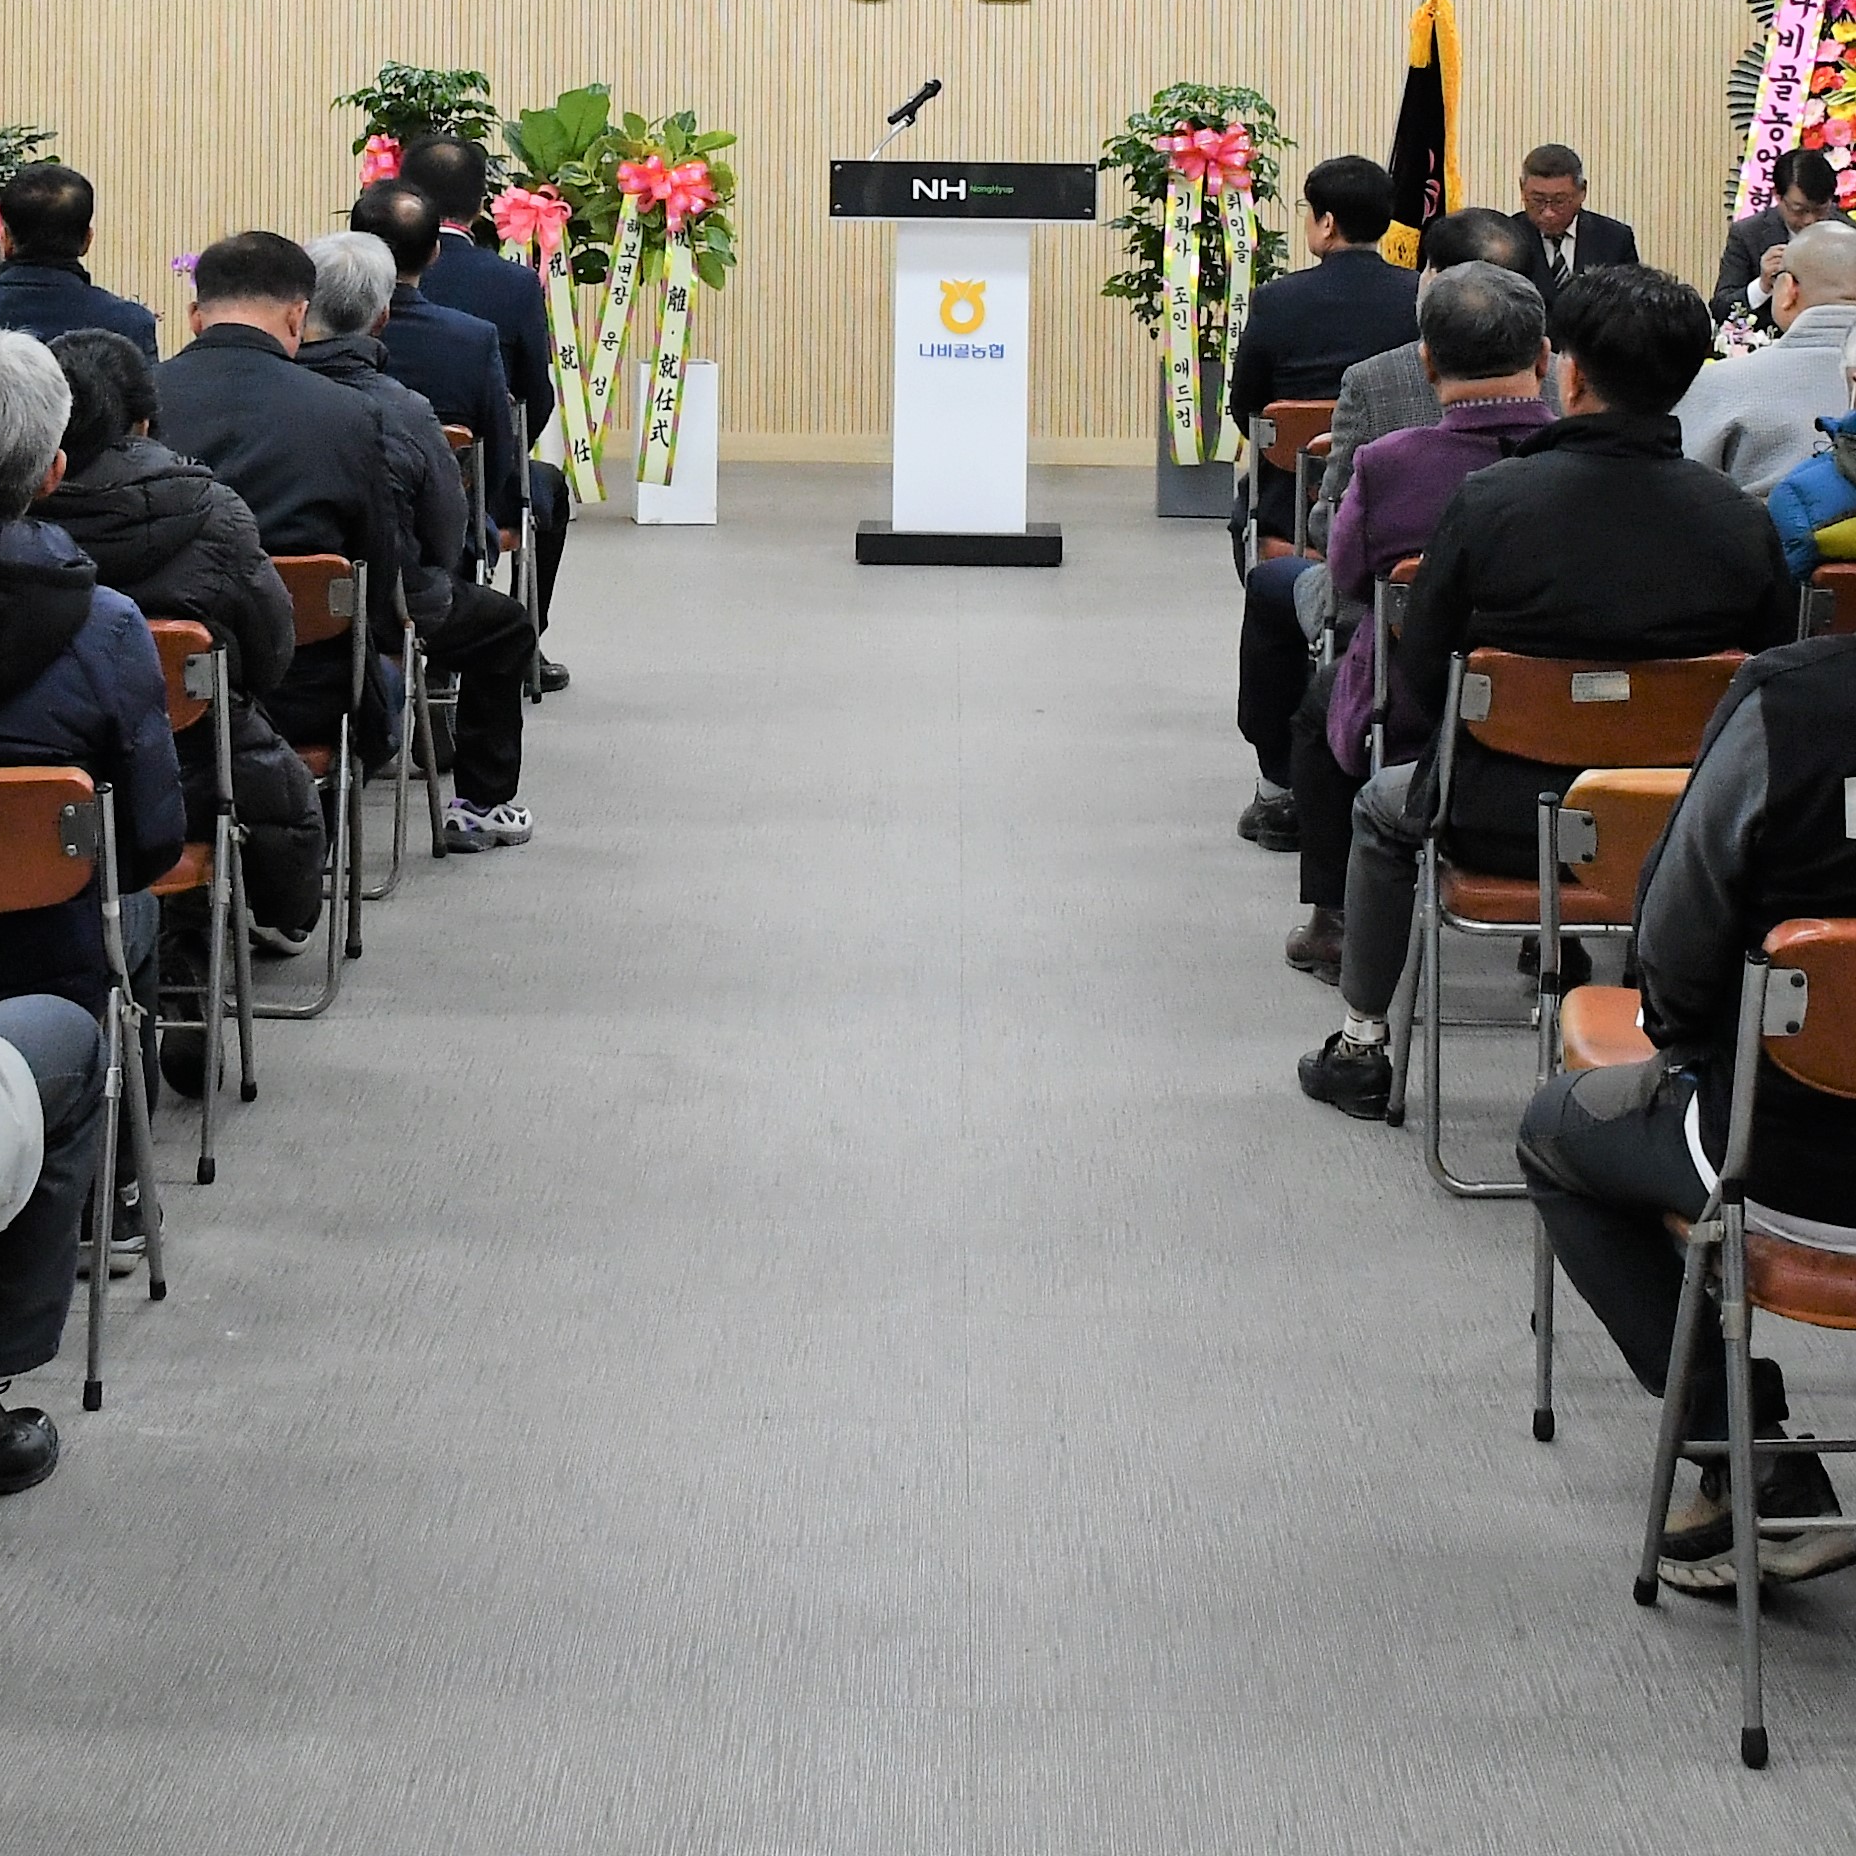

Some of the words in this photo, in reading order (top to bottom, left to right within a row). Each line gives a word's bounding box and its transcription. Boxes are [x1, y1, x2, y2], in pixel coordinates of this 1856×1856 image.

[911, 178, 967, 201] NH
[1173, 191, 1192, 259] 기획사
[1226, 191, 1250, 263] 취임을
[611, 218, 641, 306] 해보면장
[1172, 286, 1190, 331] 조인
[919, 342, 1005, 359] 나비골농협
